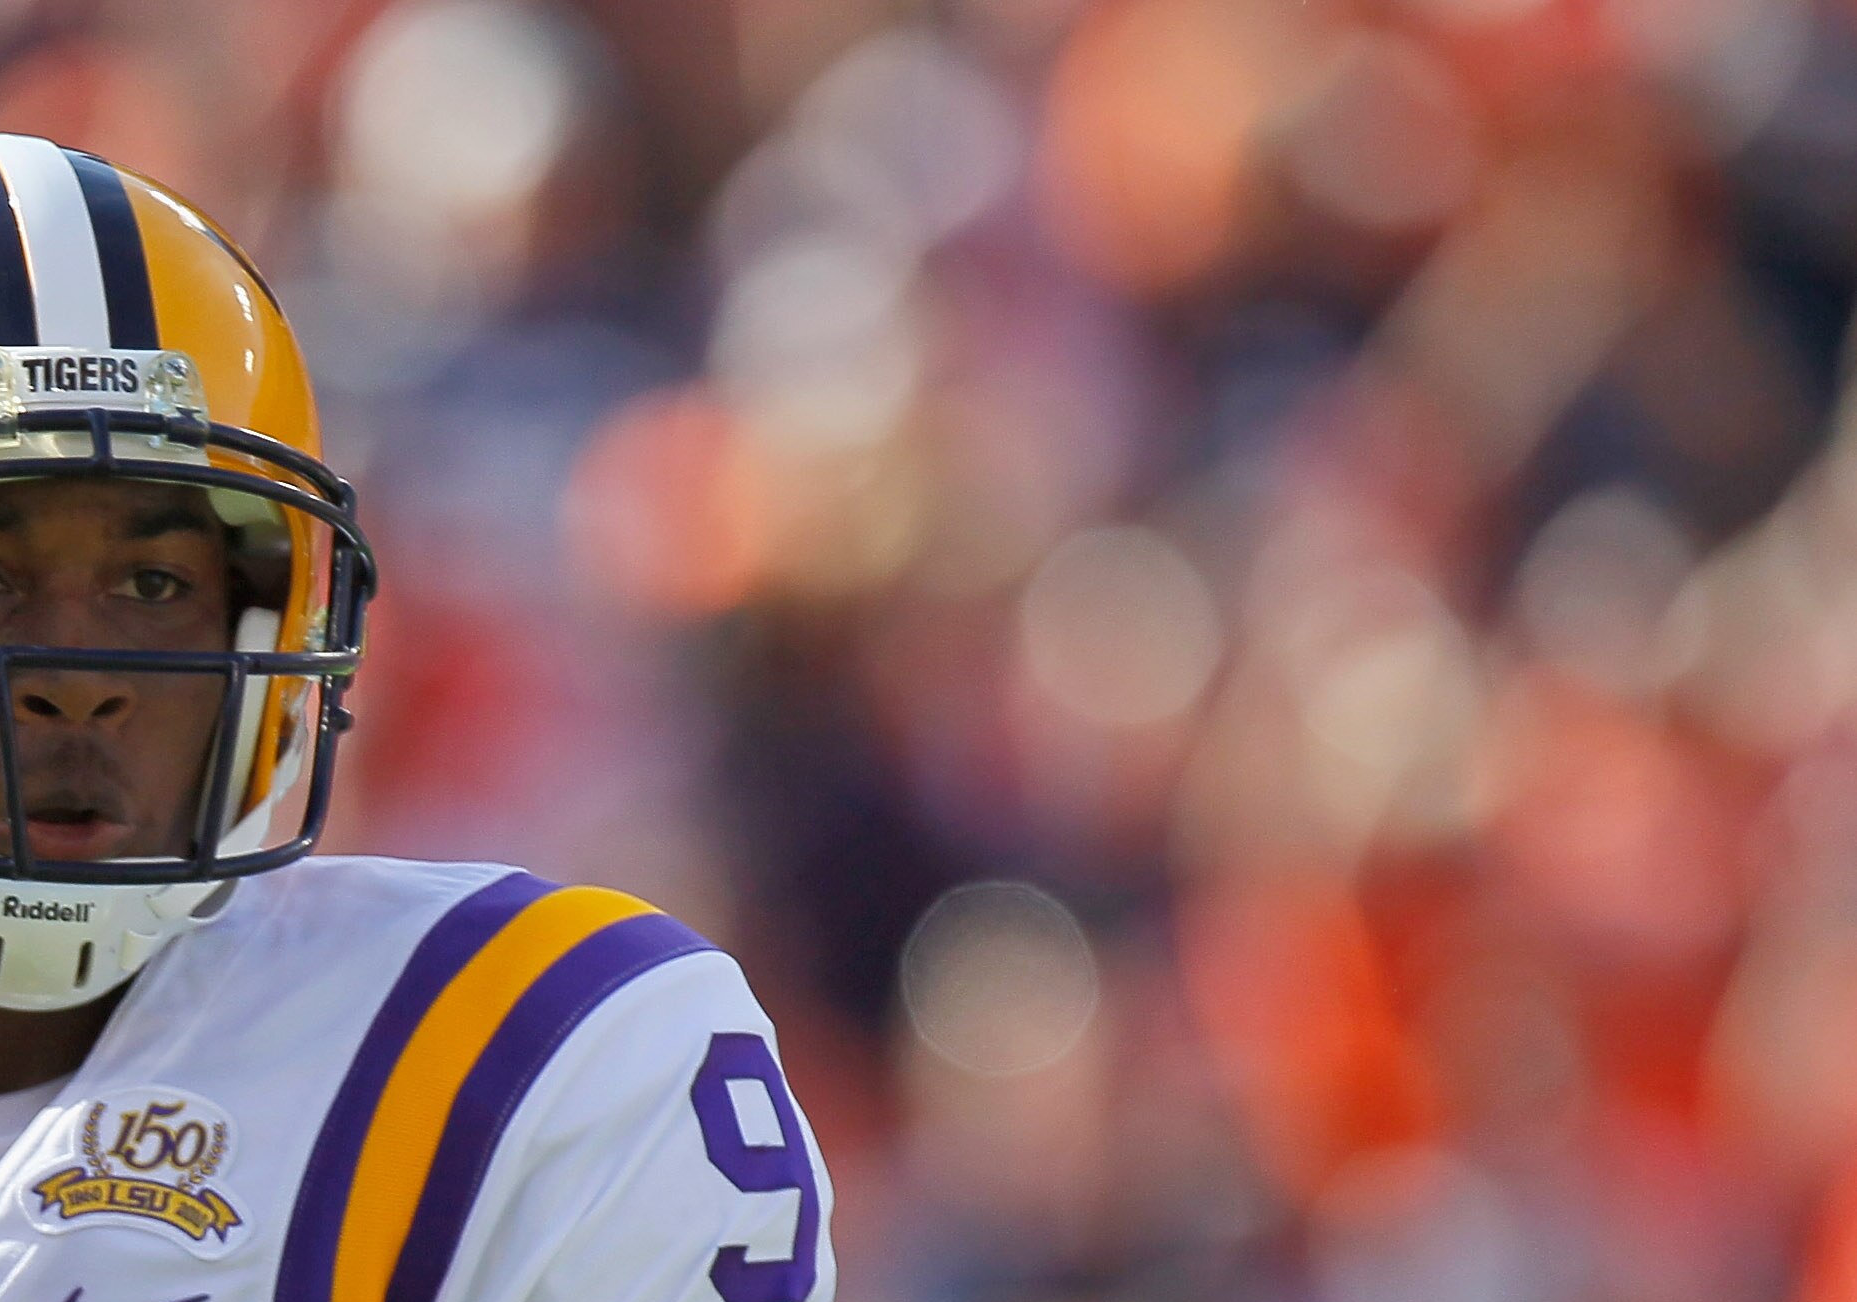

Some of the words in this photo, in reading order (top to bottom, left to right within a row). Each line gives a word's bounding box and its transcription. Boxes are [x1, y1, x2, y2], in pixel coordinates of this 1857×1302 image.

[21, 356, 139, 393] TIGERS
[2, 895, 91, 923] Riddell
[107, 1101, 207, 1172] 150
[108, 1184, 171, 1213] LSU
